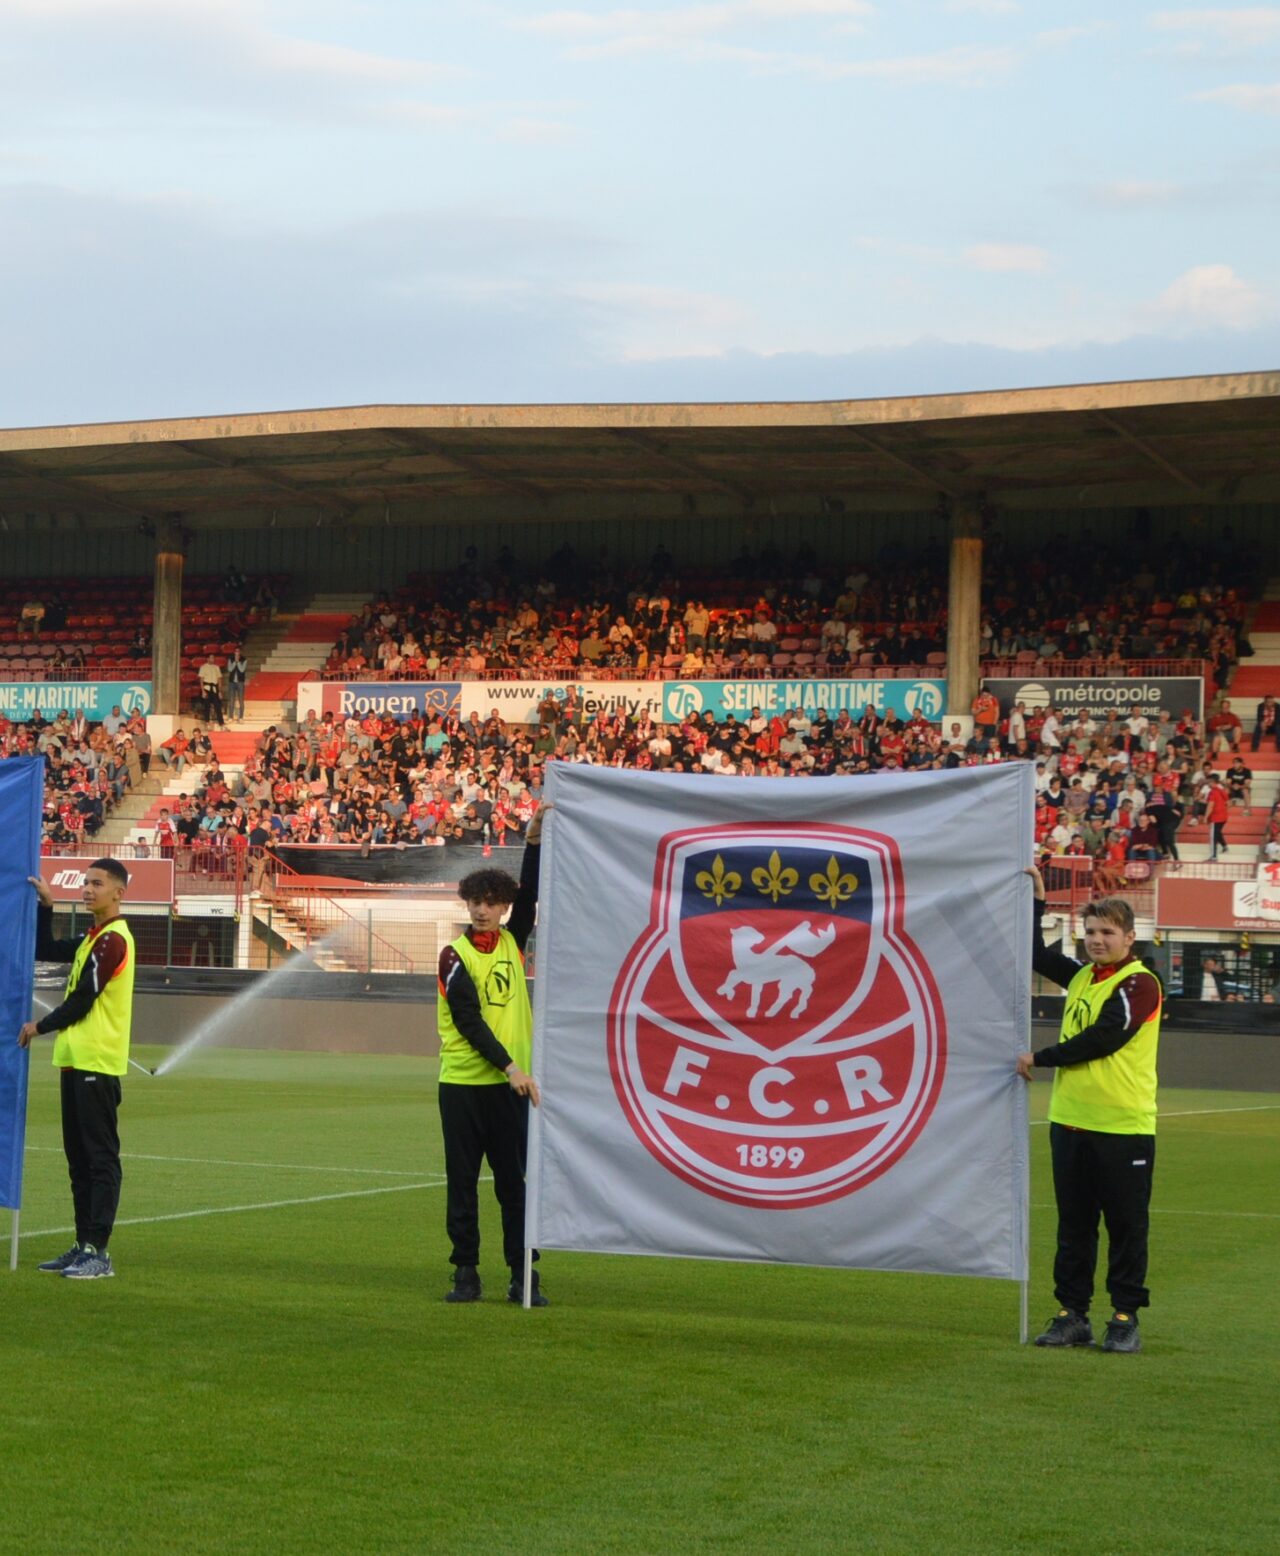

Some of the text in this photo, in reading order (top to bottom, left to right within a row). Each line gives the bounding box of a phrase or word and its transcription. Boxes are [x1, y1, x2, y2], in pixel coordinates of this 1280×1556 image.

[338, 690, 416, 715] Rouen
[722, 683, 884, 710] SEINE-MARITIME
[1055, 683, 1161, 705] métropole
[211, 907, 224, 915] WC
[736, 1144, 805, 1169] 1899
